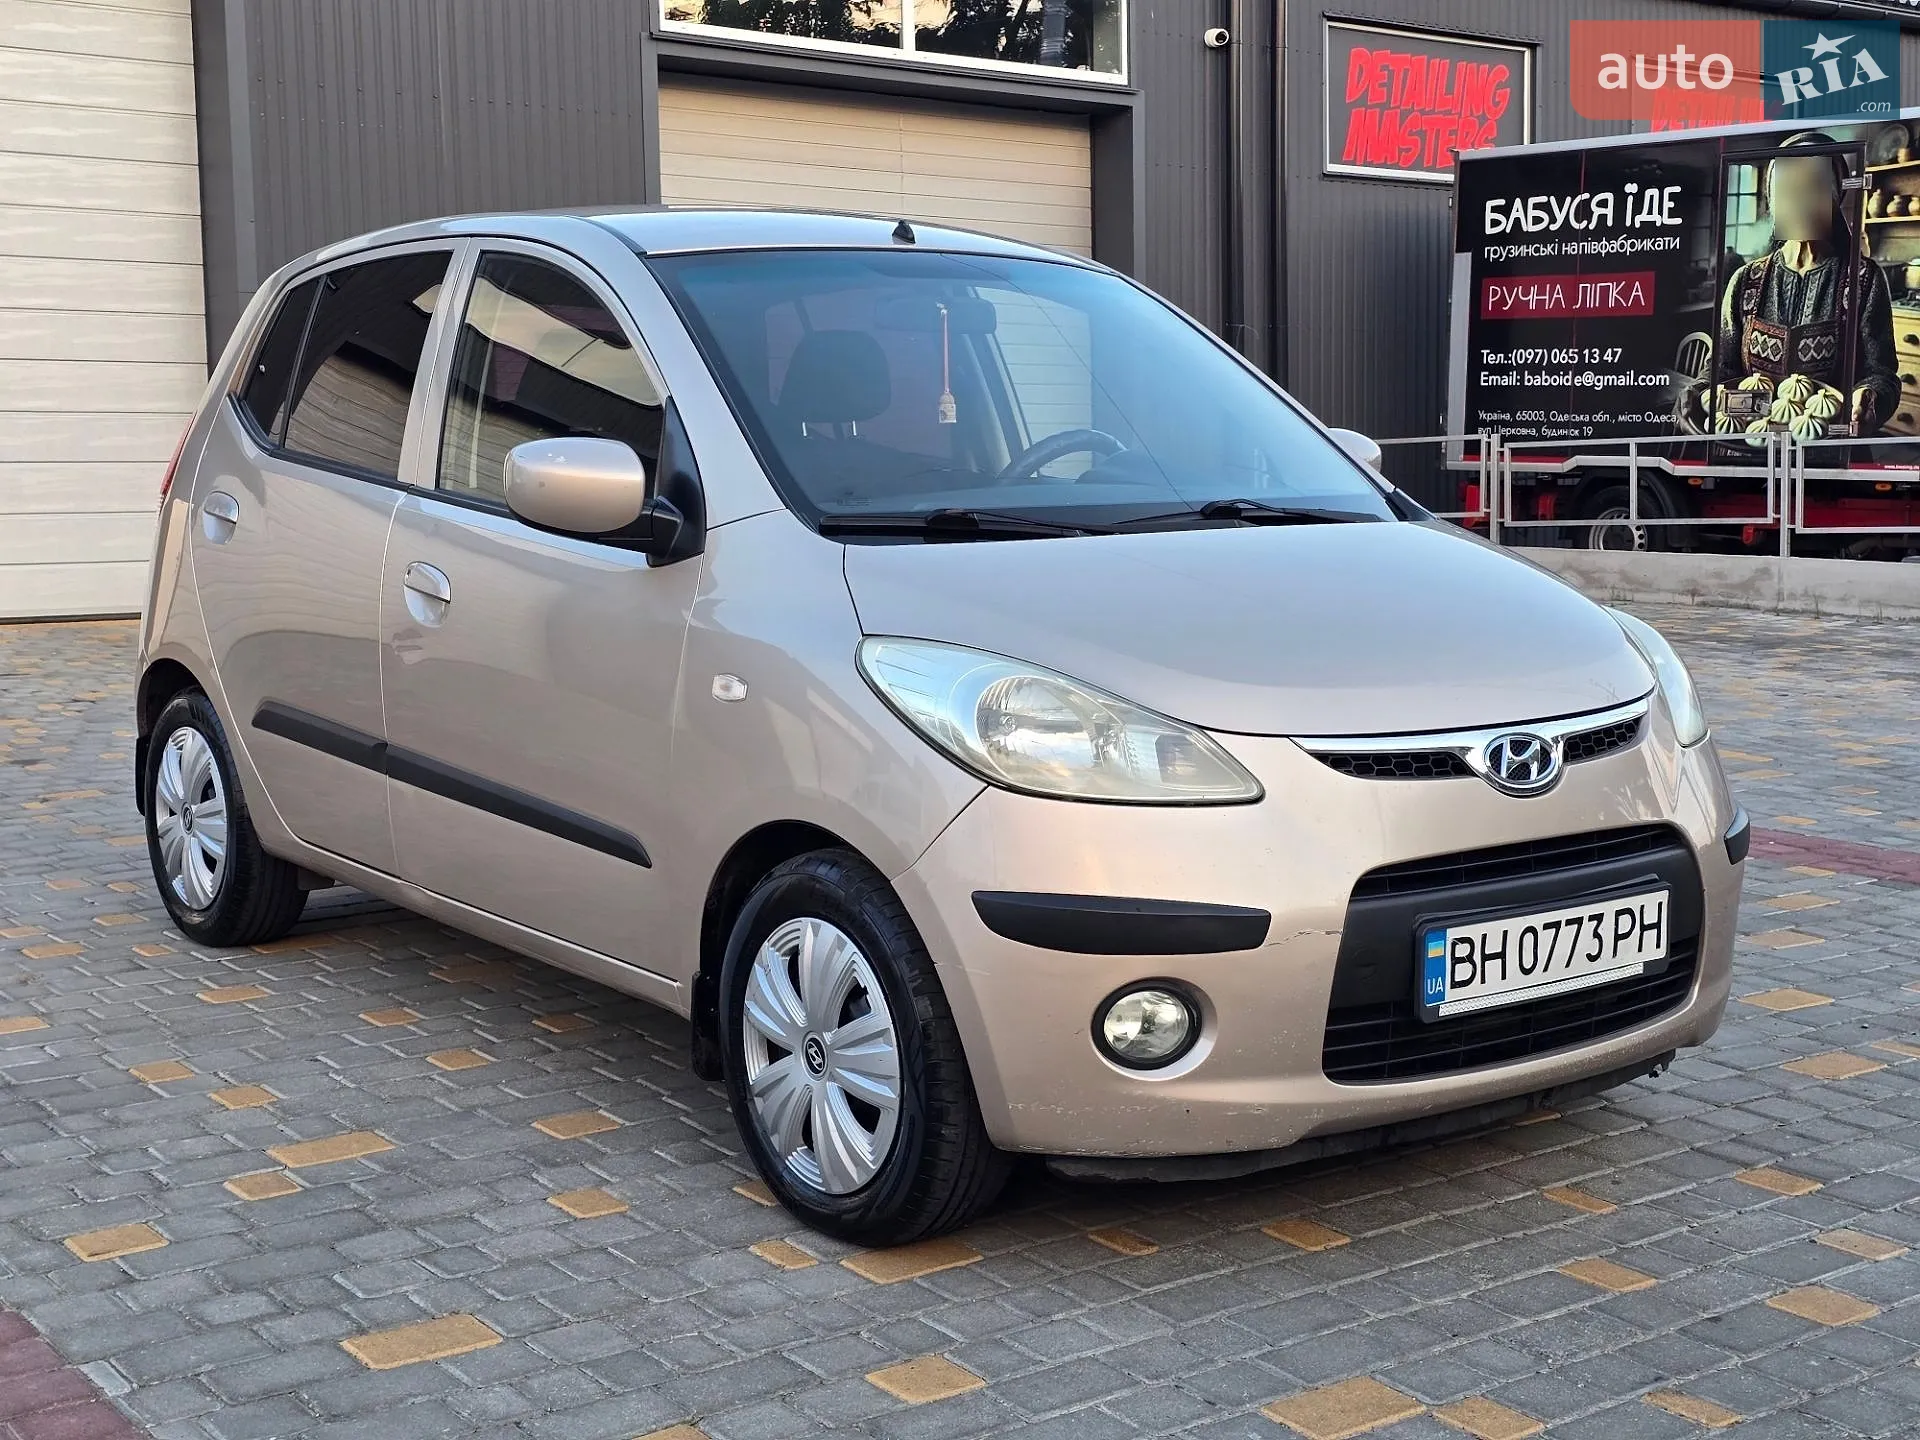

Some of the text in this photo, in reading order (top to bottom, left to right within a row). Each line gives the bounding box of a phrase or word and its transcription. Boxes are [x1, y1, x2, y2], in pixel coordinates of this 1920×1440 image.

[1346, 47, 1511, 120] DETAILING
[1343, 108, 1497, 168] MASTERS
[1484, 182, 1683, 235] БАБУСЯ ЇДЕ
[1484, 234, 1681, 262] грузинські напівфабрикати
[1488, 281, 1645, 311] РУЧНА ЛІПКА
[1551, 348, 1579, 364] 065
[1583, 348, 1600, 364] 13
[1603, 347, 1622, 363] 47
[1480, 370, 1520, 386] Email:
[1477, 410, 1513, 423] Україна,
[1515, 411, 1547, 423] 65003,
[1618, 411, 1643, 422] місто
[1644, 411, 1680, 424] Одеса,
[1582, 426, 1594, 437] 19
[1450, 901, 1663, 990] BH 0773 PH
[1427, 976, 1444, 995] UA
